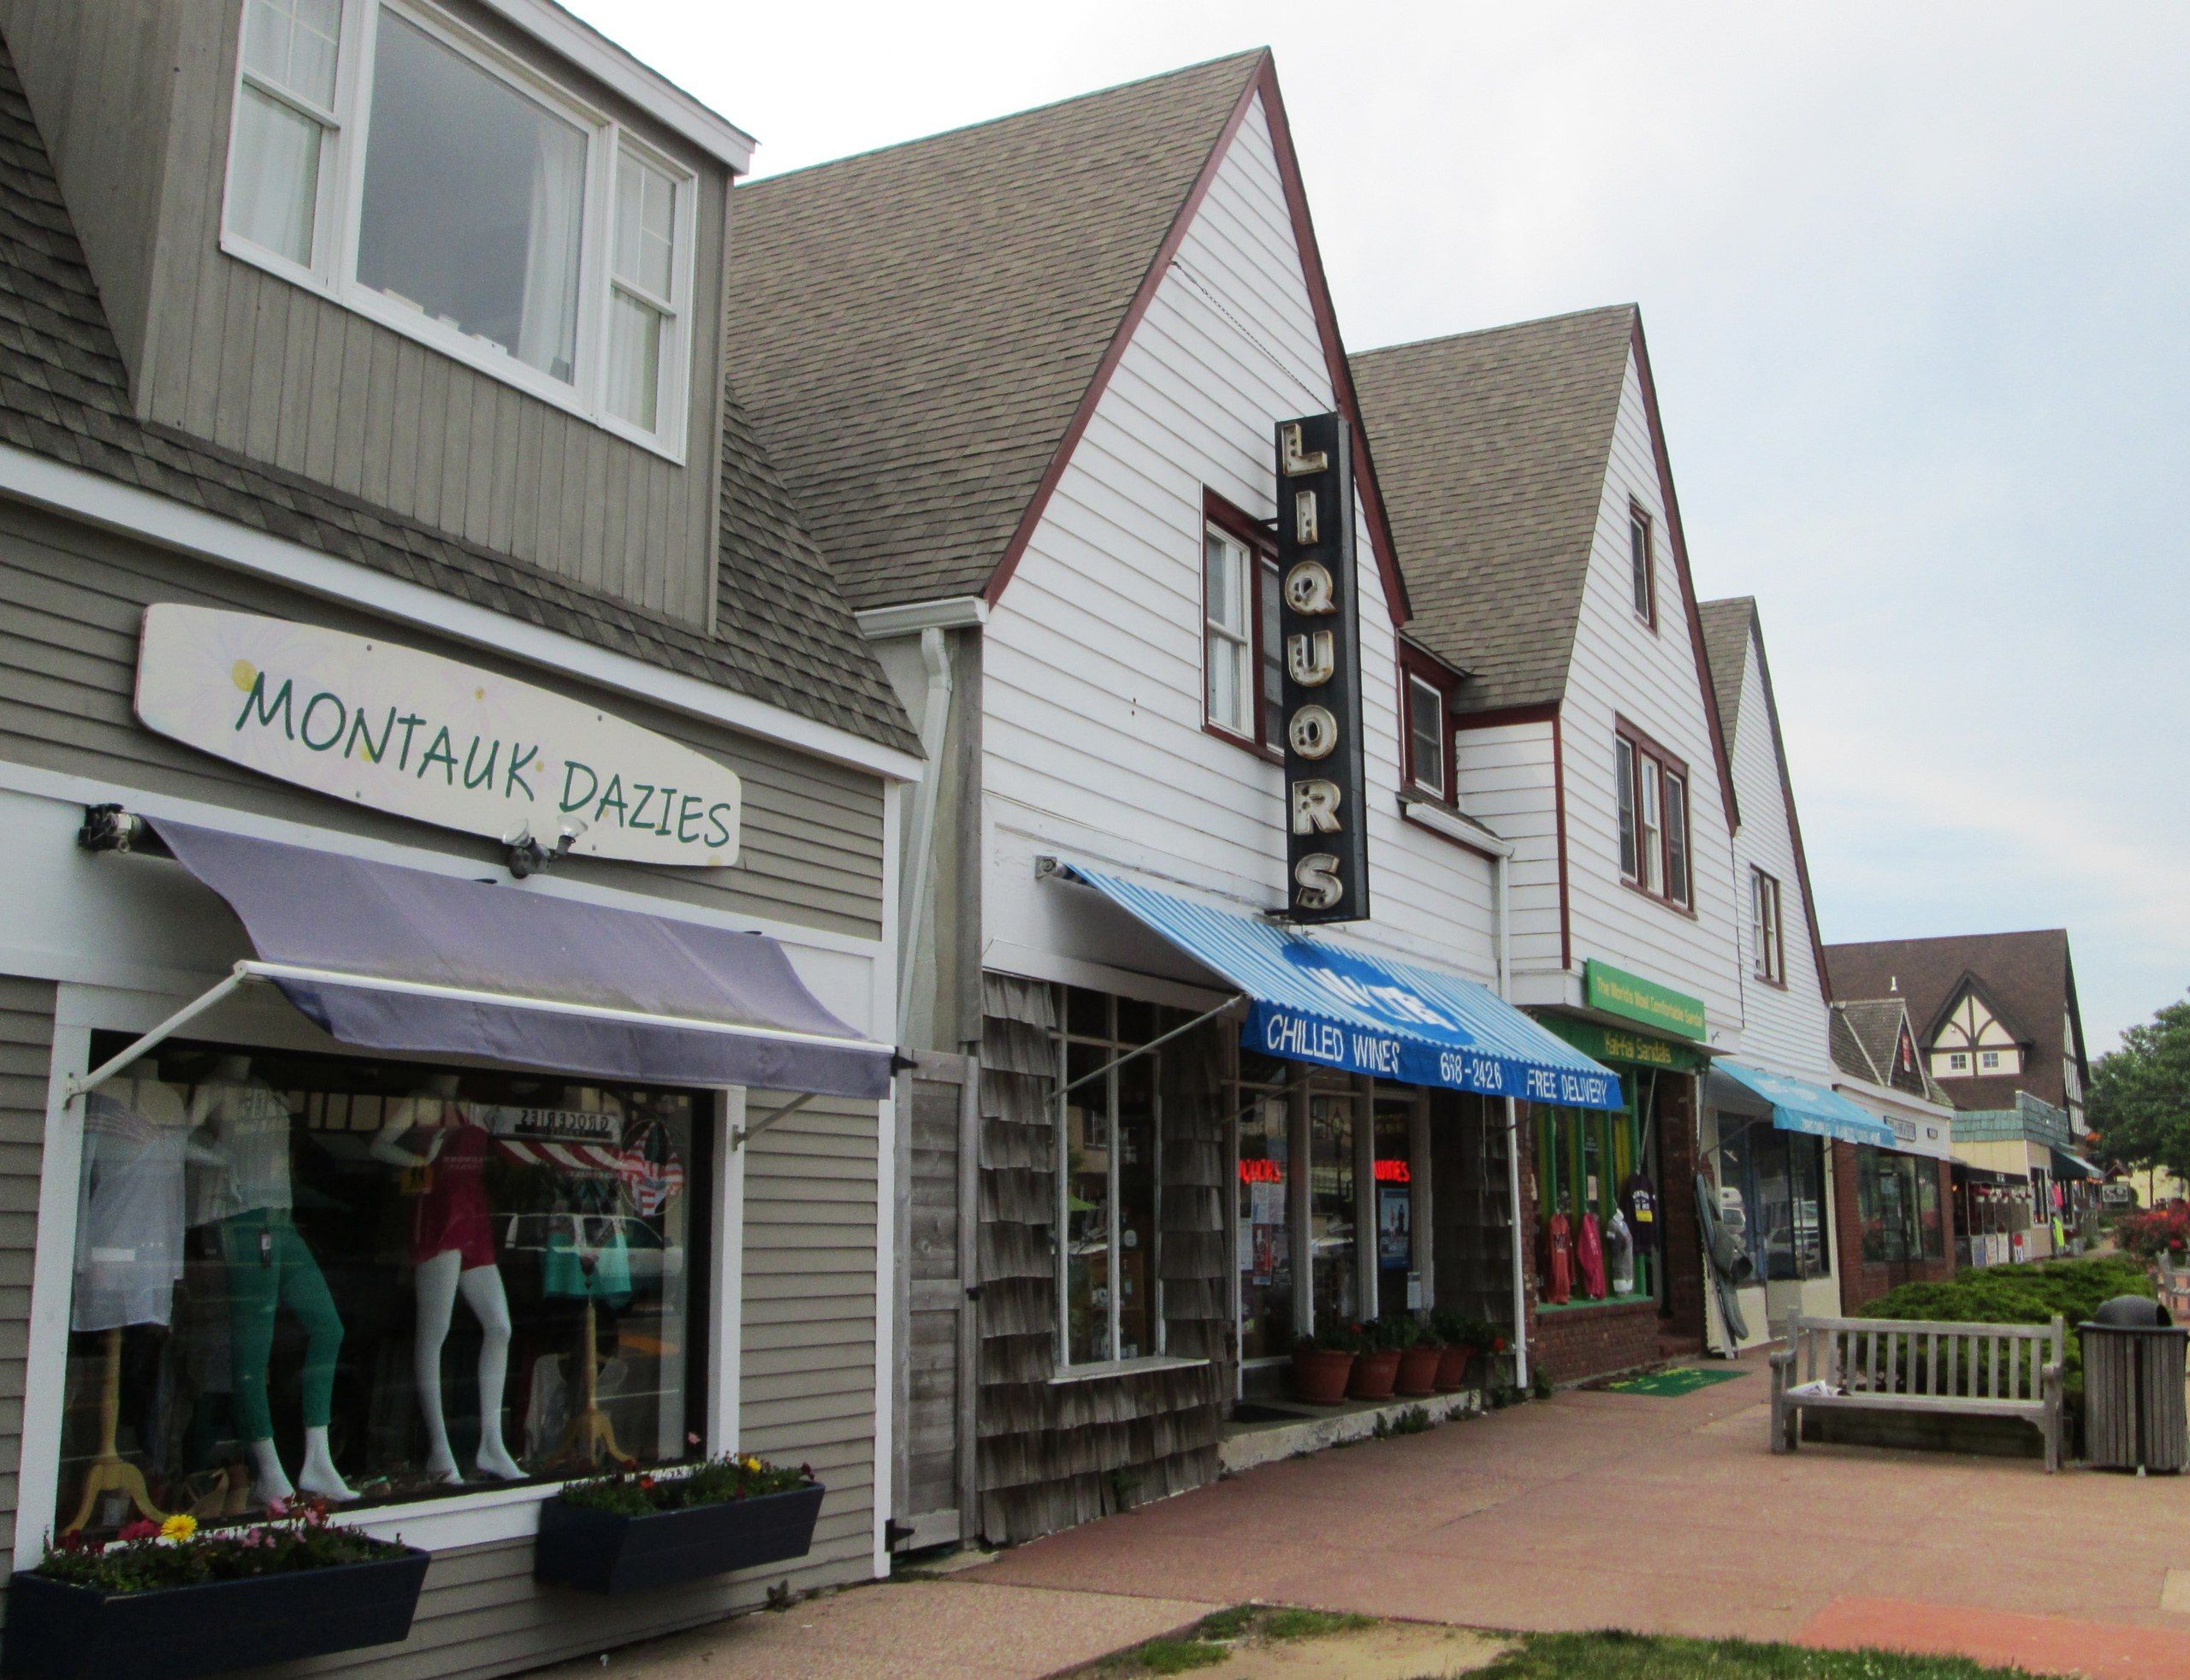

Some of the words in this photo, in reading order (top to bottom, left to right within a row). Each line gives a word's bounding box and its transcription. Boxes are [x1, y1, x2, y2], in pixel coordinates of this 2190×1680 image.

[1281, 423, 1343, 910] LIQUORS
[234, 670, 542, 802] MONTAUK
[558, 760, 732, 849] DAZIES
[1267, 1014, 1344, 1062] CHILLED
[1352, 1032, 1400, 1074] WINES
[1526, 1069, 1557, 1100] FREE
[1560, 1074, 1608, 1105] DELIVERY
